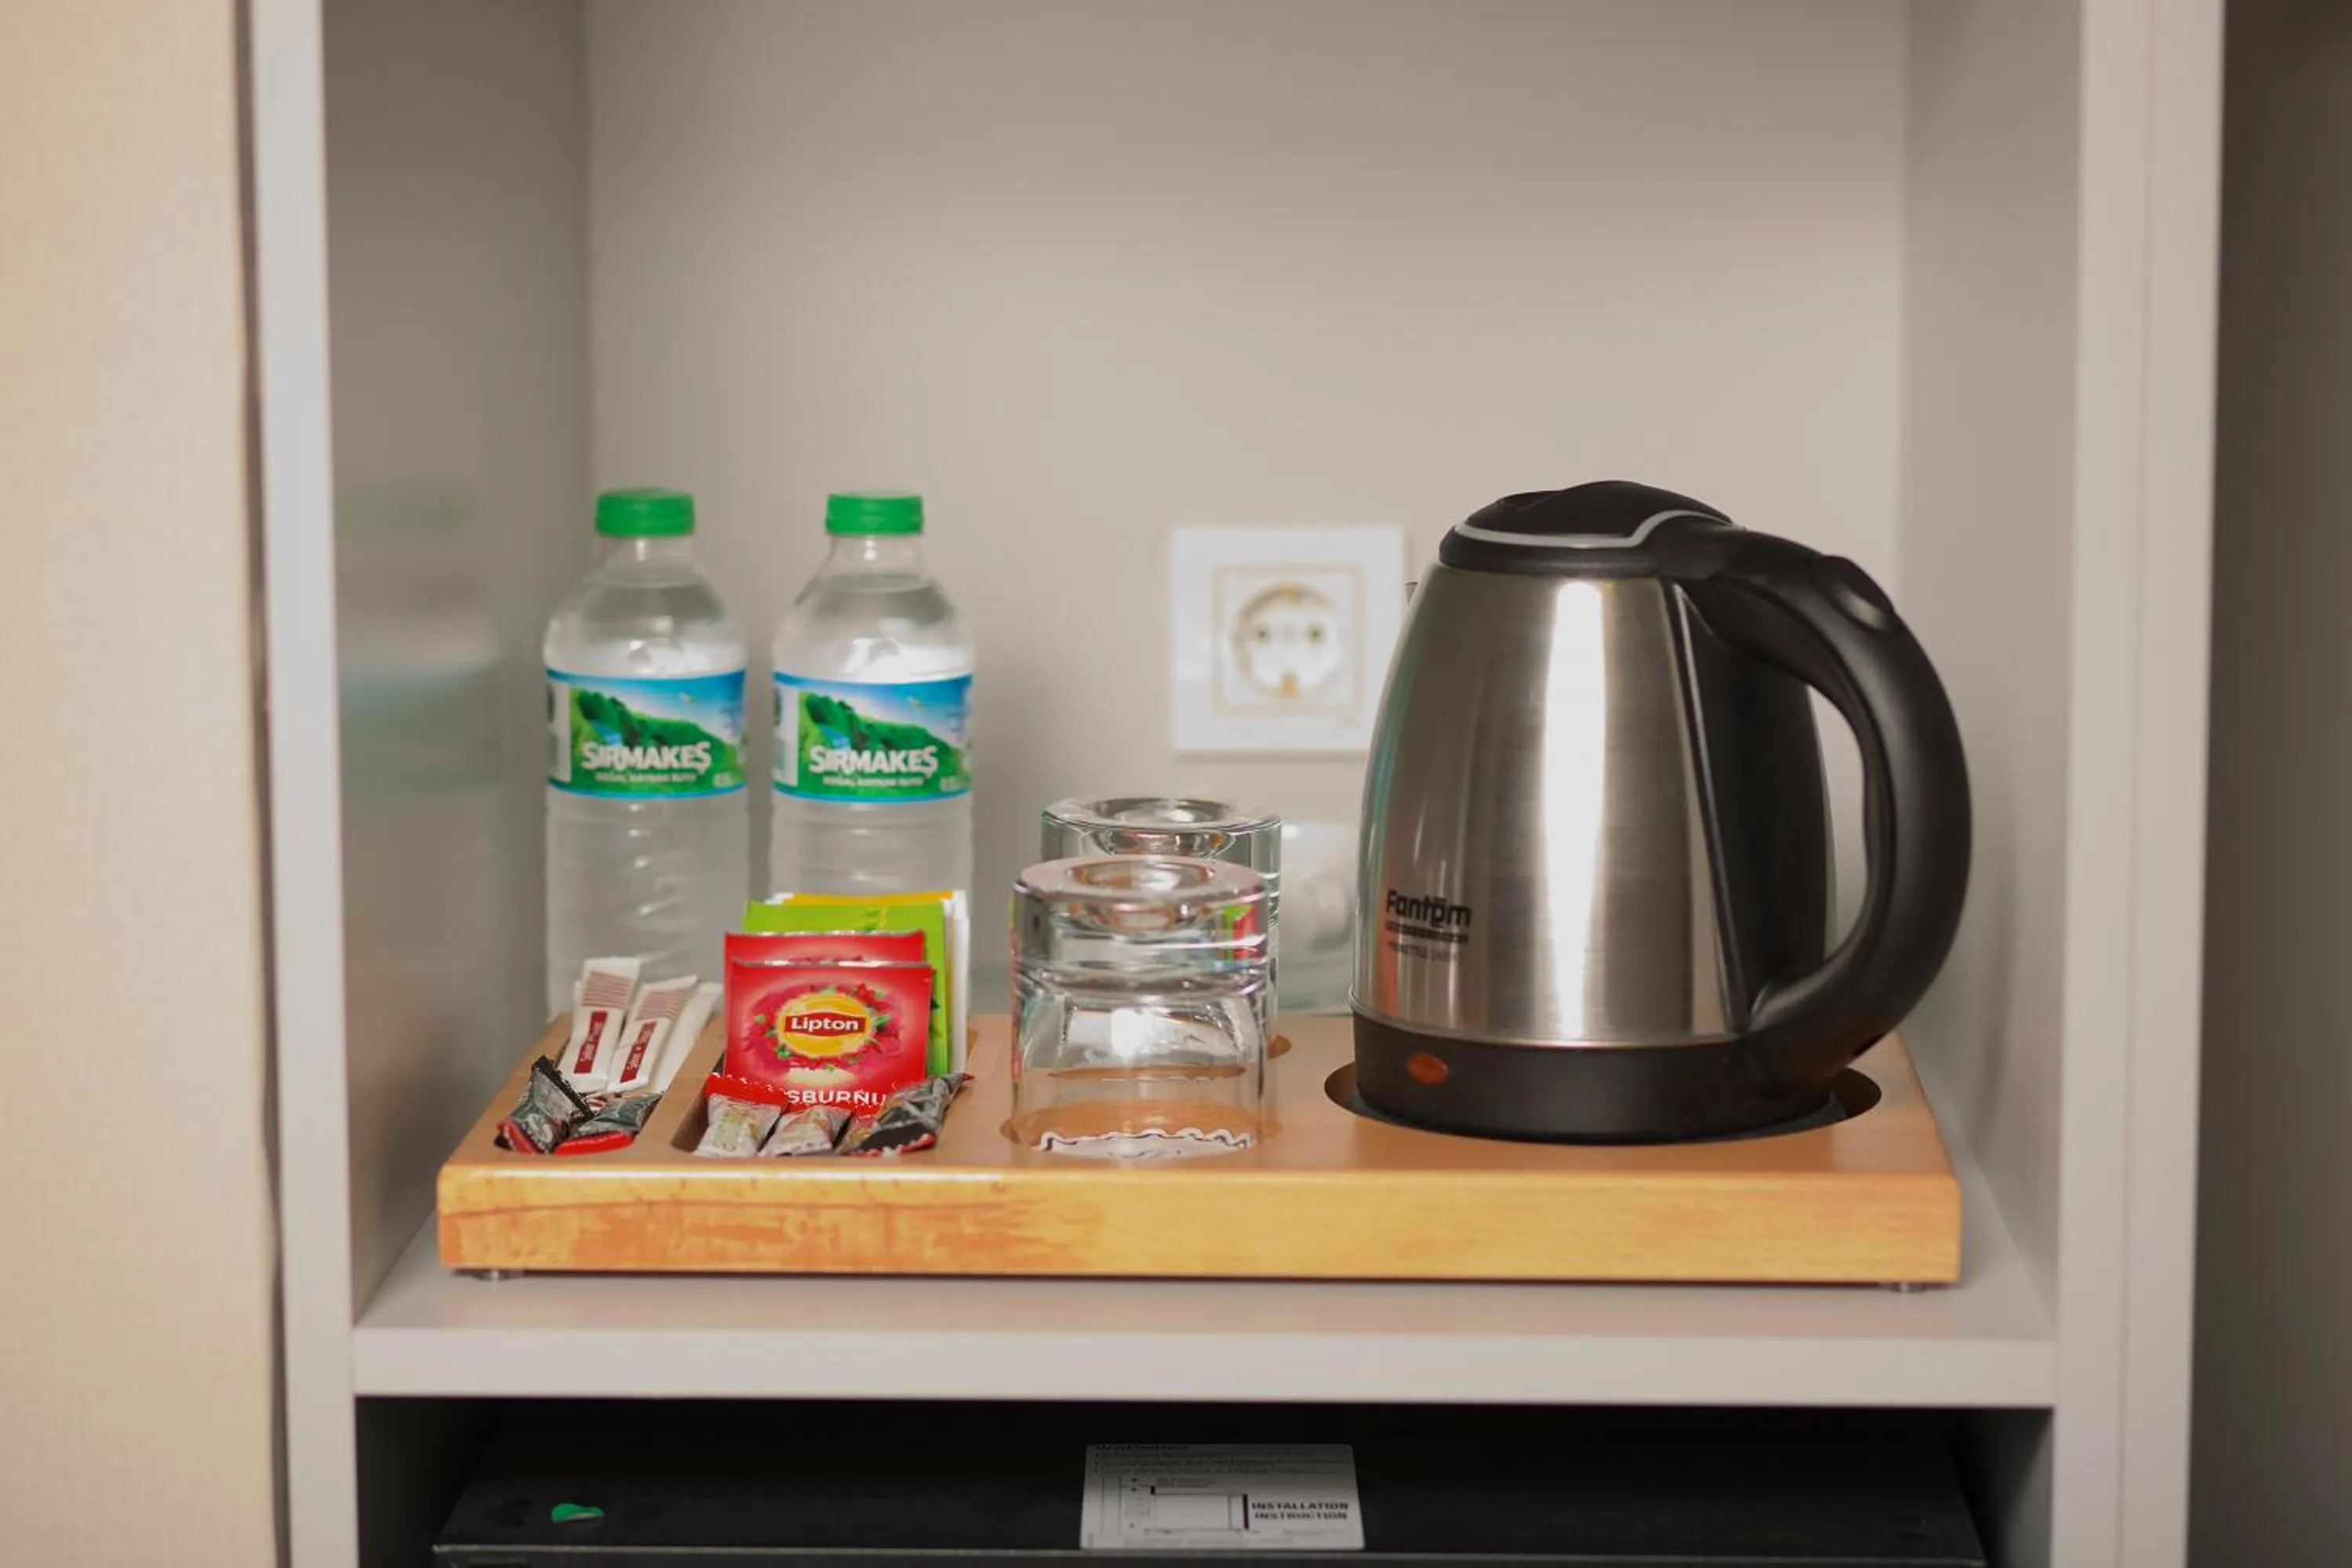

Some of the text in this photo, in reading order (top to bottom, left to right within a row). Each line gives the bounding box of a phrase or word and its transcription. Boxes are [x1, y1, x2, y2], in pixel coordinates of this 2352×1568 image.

[791, 1017, 859, 1033] Lipton
[786, 1090, 887, 1105] SBURNU
[1251, 1501, 1349, 1510] INSTALLATION
[1254, 1511, 1348, 1519] INSTRUCTION
